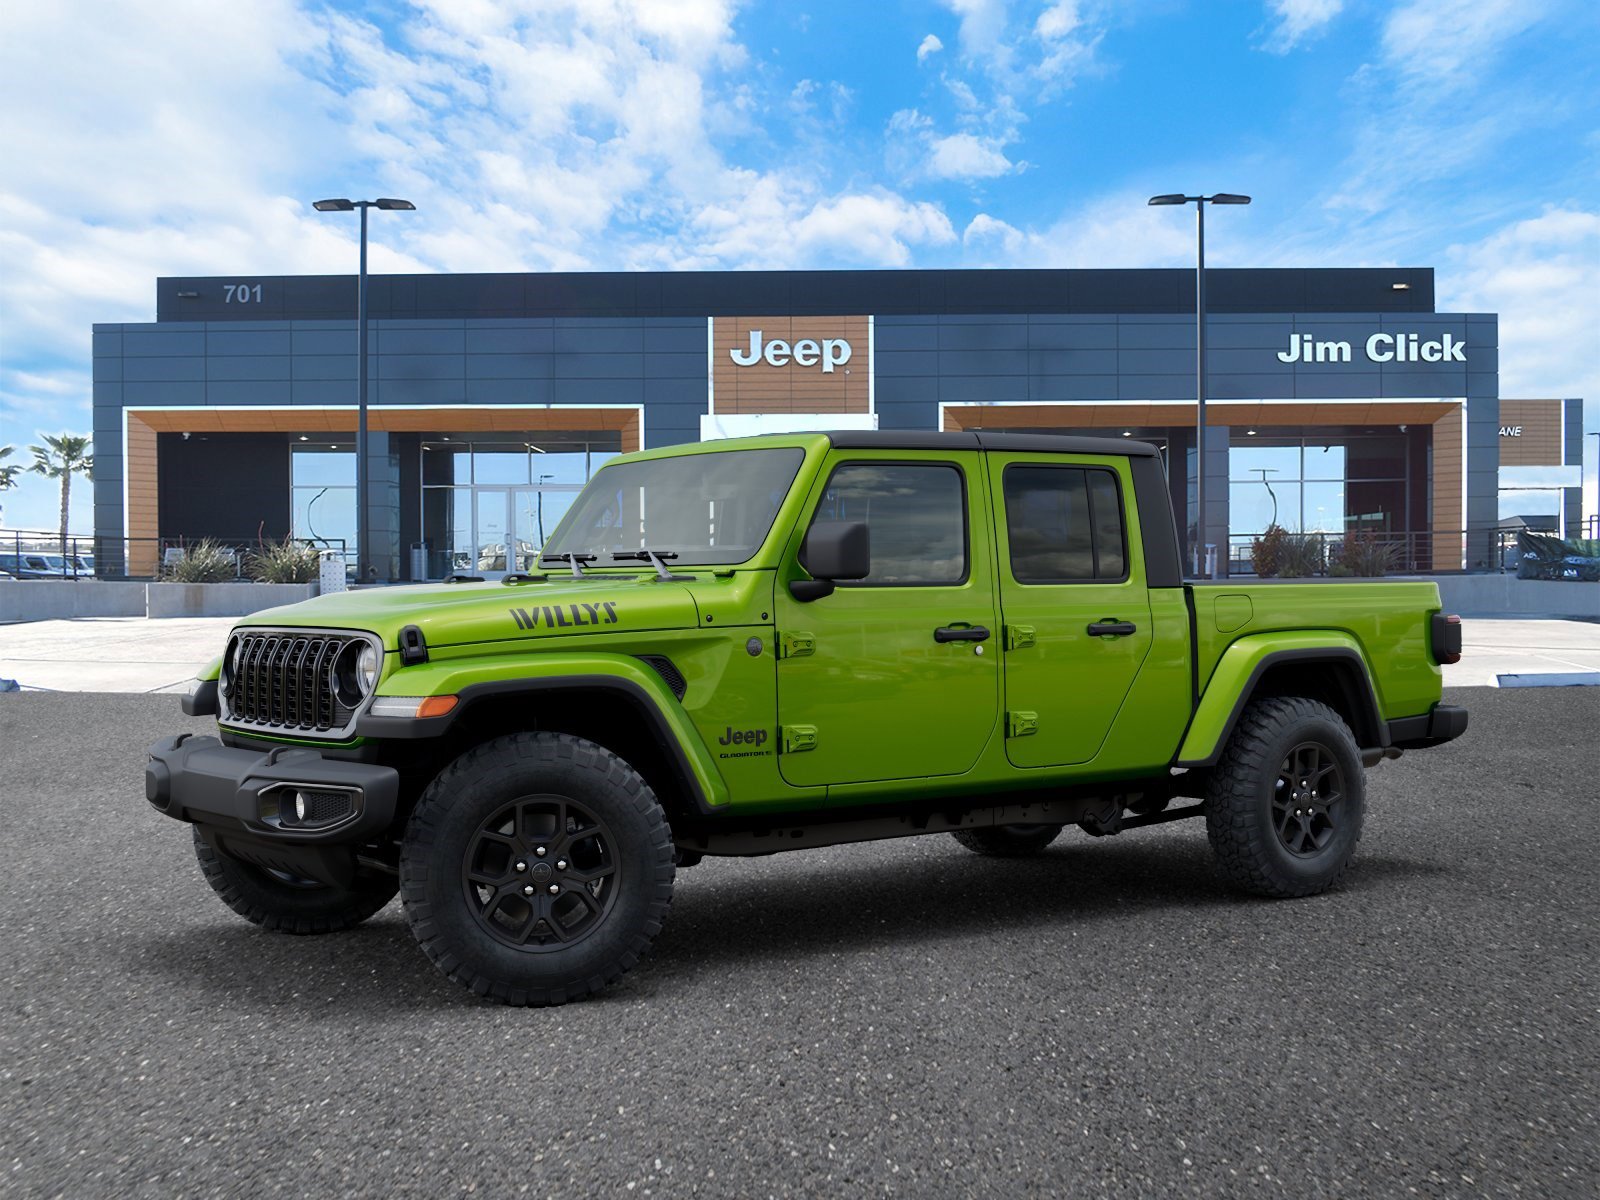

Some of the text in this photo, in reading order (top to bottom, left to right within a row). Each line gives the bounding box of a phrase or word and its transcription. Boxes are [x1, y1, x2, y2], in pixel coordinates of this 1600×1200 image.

[223, 284, 262, 303] 701
[729, 330, 852, 373] Jeep
[1277, 333, 1467, 362] Jim Click
[508, 601, 618, 630] WILLYS
[719, 727, 768, 747] Jeep
